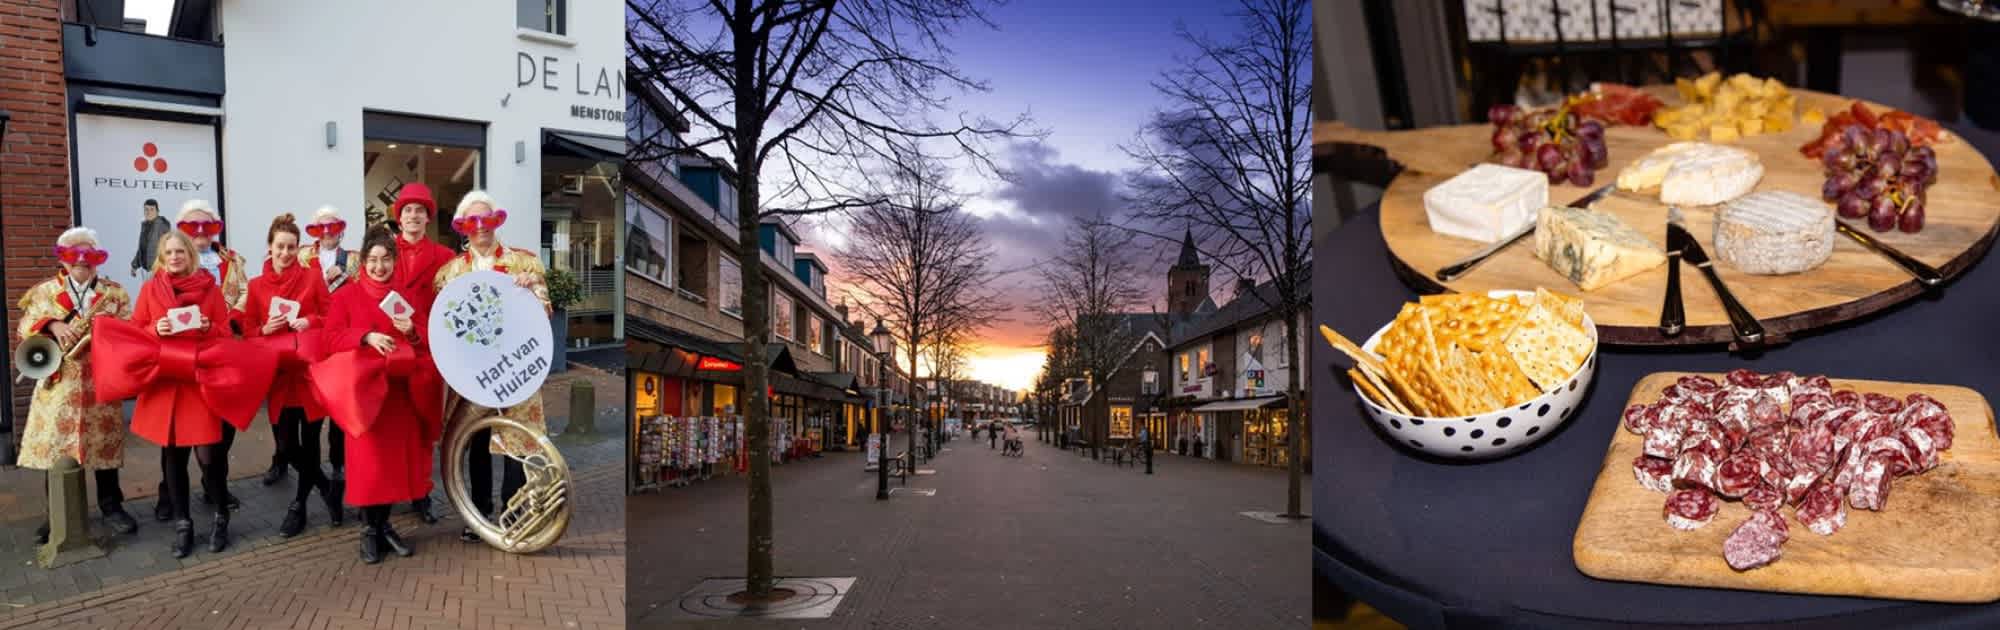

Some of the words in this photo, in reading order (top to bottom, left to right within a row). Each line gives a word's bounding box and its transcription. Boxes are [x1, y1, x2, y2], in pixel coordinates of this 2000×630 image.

[517, 51, 558, 91] DE
[94, 177, 203, 191] PEUTEREY
[476, 354, 513, 389] Hart
[512, 337, 539, 360] van
[493, 356, 547, 402] Huizen
